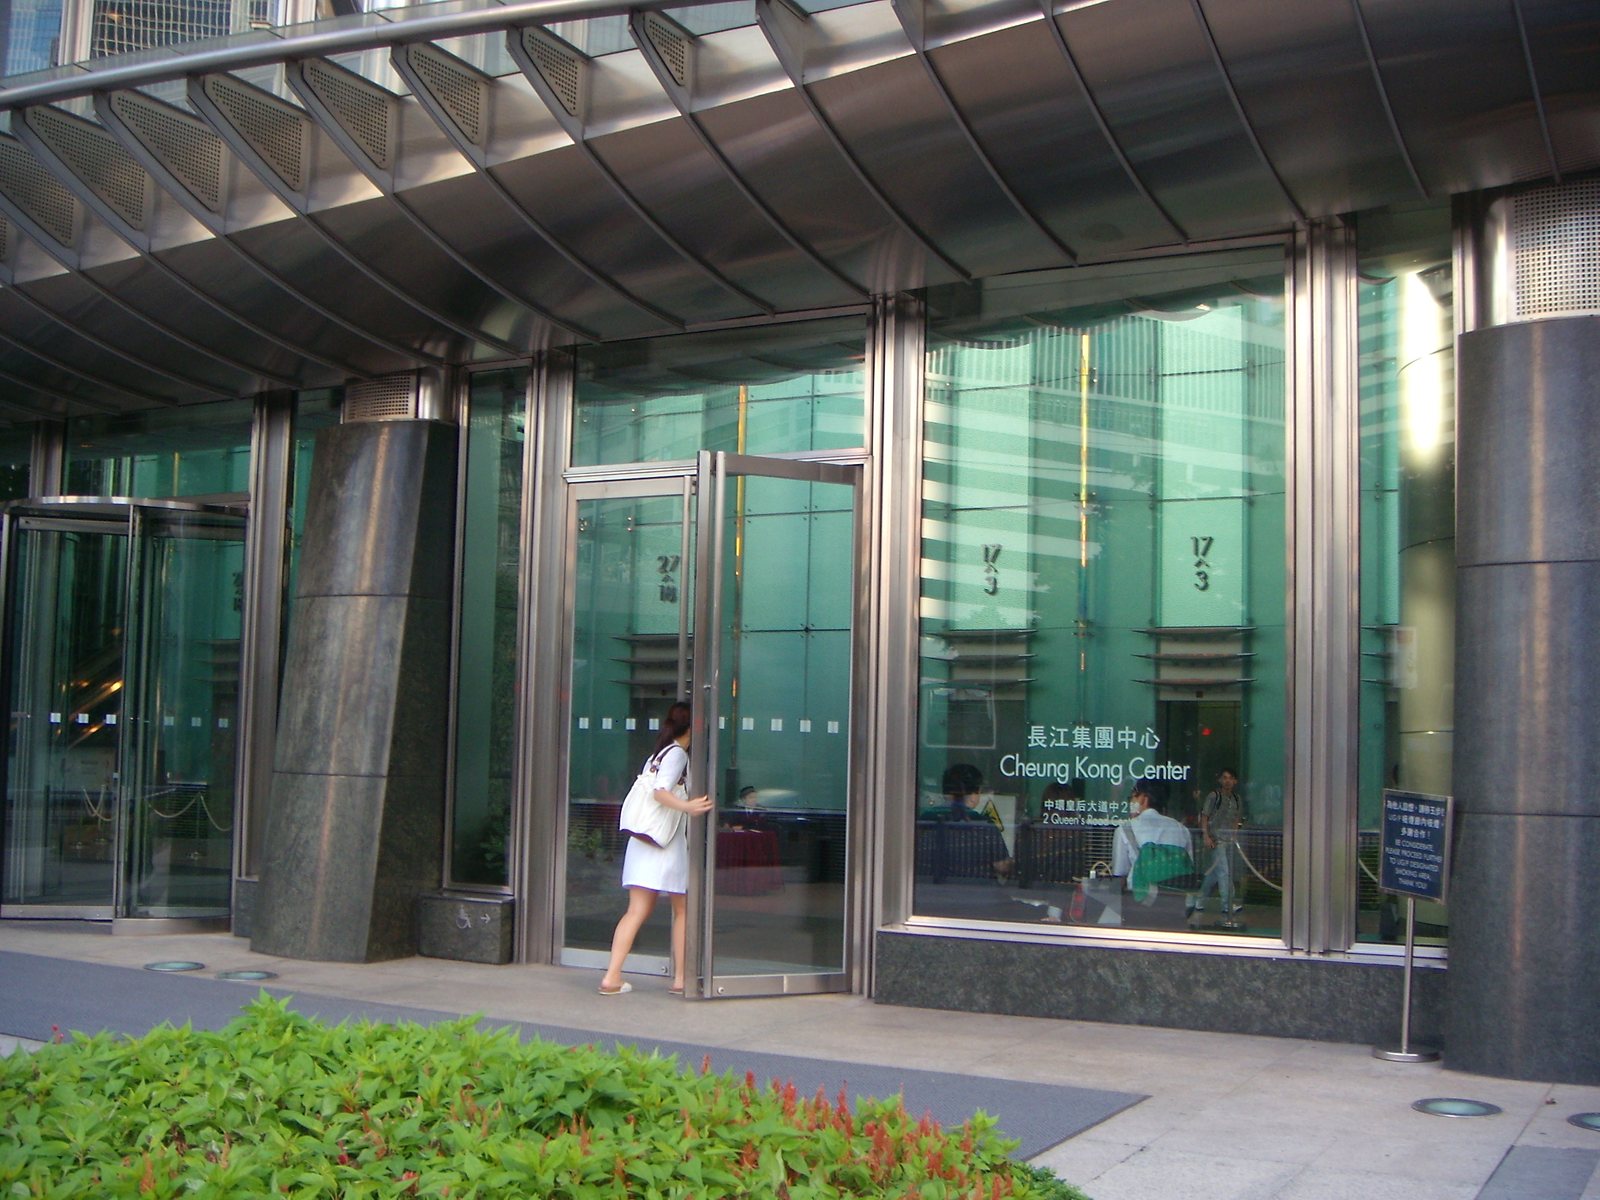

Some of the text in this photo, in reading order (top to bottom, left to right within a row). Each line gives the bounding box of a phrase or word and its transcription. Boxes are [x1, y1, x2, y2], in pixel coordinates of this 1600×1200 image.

[981, 543, 1002, 563] 17
[1190, 535, 1214, 557] 17
[656, 555, 681, 574] 27
[1193, 571, 1210, 592] 3
[1027, 725, 1160, 750] 長江集團中心
[999, 753, 1191, 786] Cheung Kong Center
[1043, 813, 1049, 824] 2
[1051, 813, 1085, 826] Queen's
